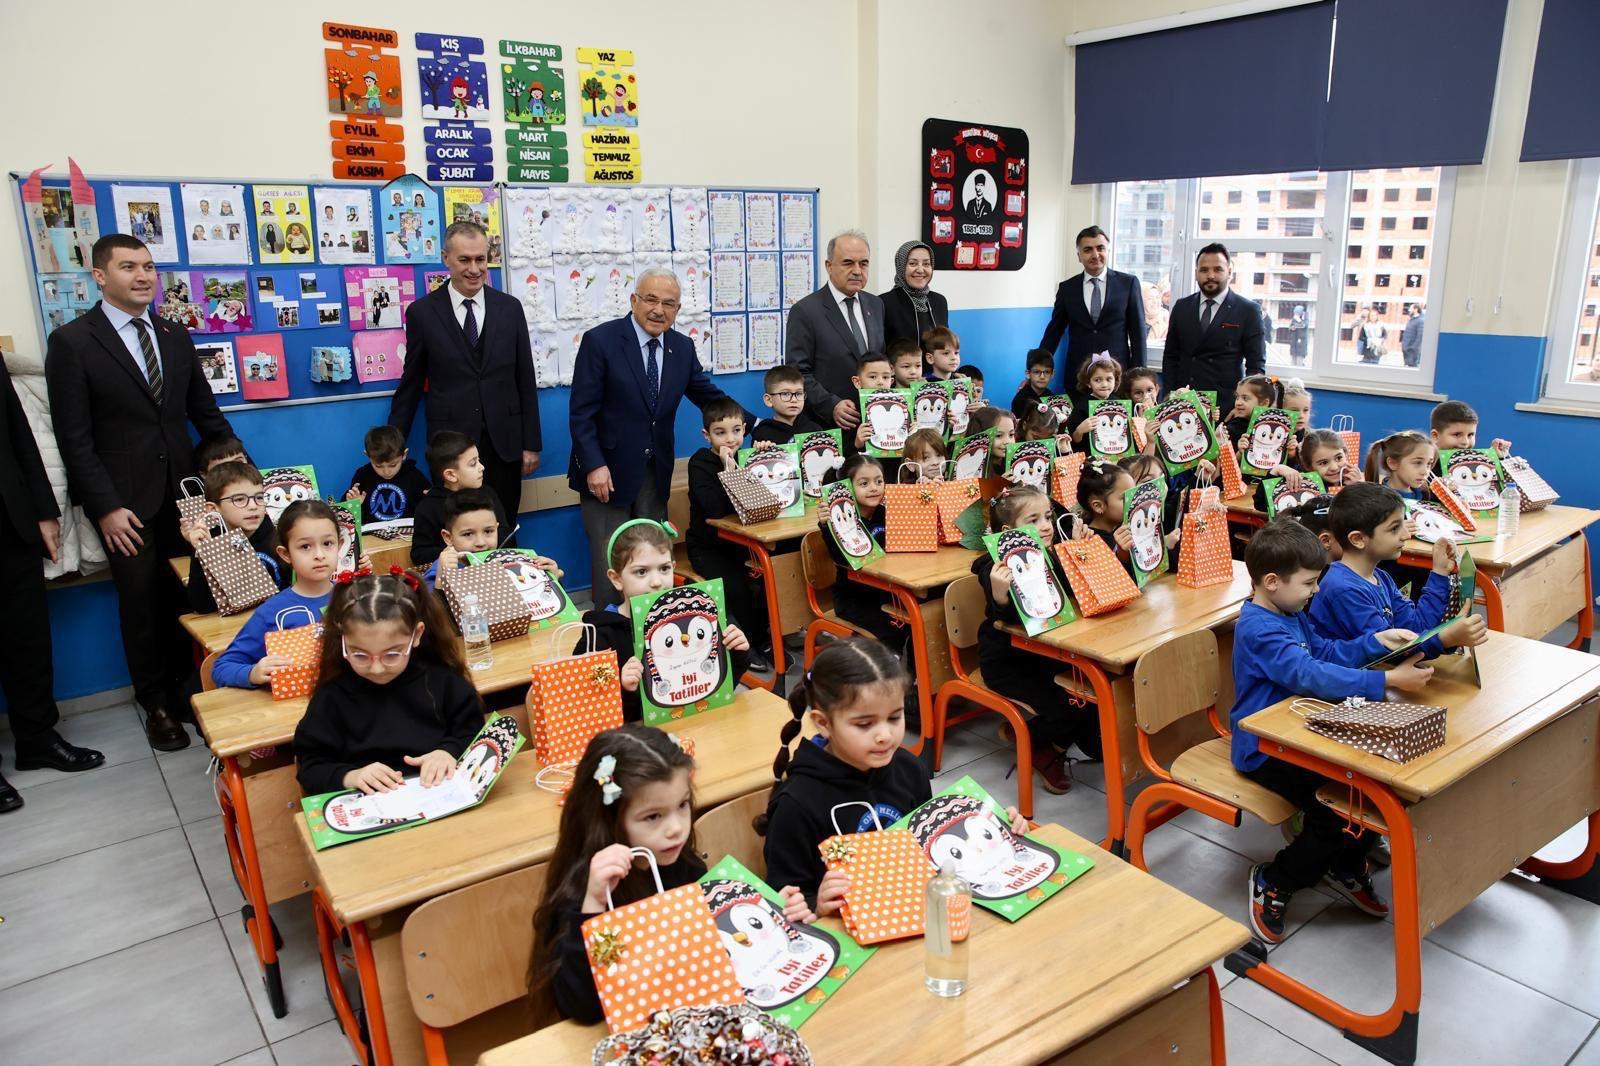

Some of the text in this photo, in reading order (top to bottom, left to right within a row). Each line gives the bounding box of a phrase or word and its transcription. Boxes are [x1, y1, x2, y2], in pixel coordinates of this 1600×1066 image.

[329, 26, 393, 43] SONBAHAR
[440, 38, 460, 52] KIŞ
[506, 41, 556, 57] İLKBAHAR
[597, 52, 615, 62] YAZ
[344, 124, 379, 137] EYLÜL
[434, 129, 473, 140] ARALIK
[518, 131, 549, 143] MART
[591, 132, 630, 144] HAZİRAN
[345, 142, 375, 157] EKİM
[436, 147, 470, 159] OCAK
[519, 148, 551, 161] NİSAN
[592, 152, 631, 162] TEMMUZ
[347, 165, 385, 177] KASIM
[439, 167, 476, 180] ŞUBAT
[520, 168, 551, 180] MAYIS
[593, 168, 634, 181] AĞUSTOS
[962, 224, 993, 235] 1881-1938
[1179, 446, 1204, 460] Tatiller
[669, 682, 711, 702] Tatiller
[1005, 862, 1049, 890] Tatiller
[780, 953, 828, 994] Tatiller
